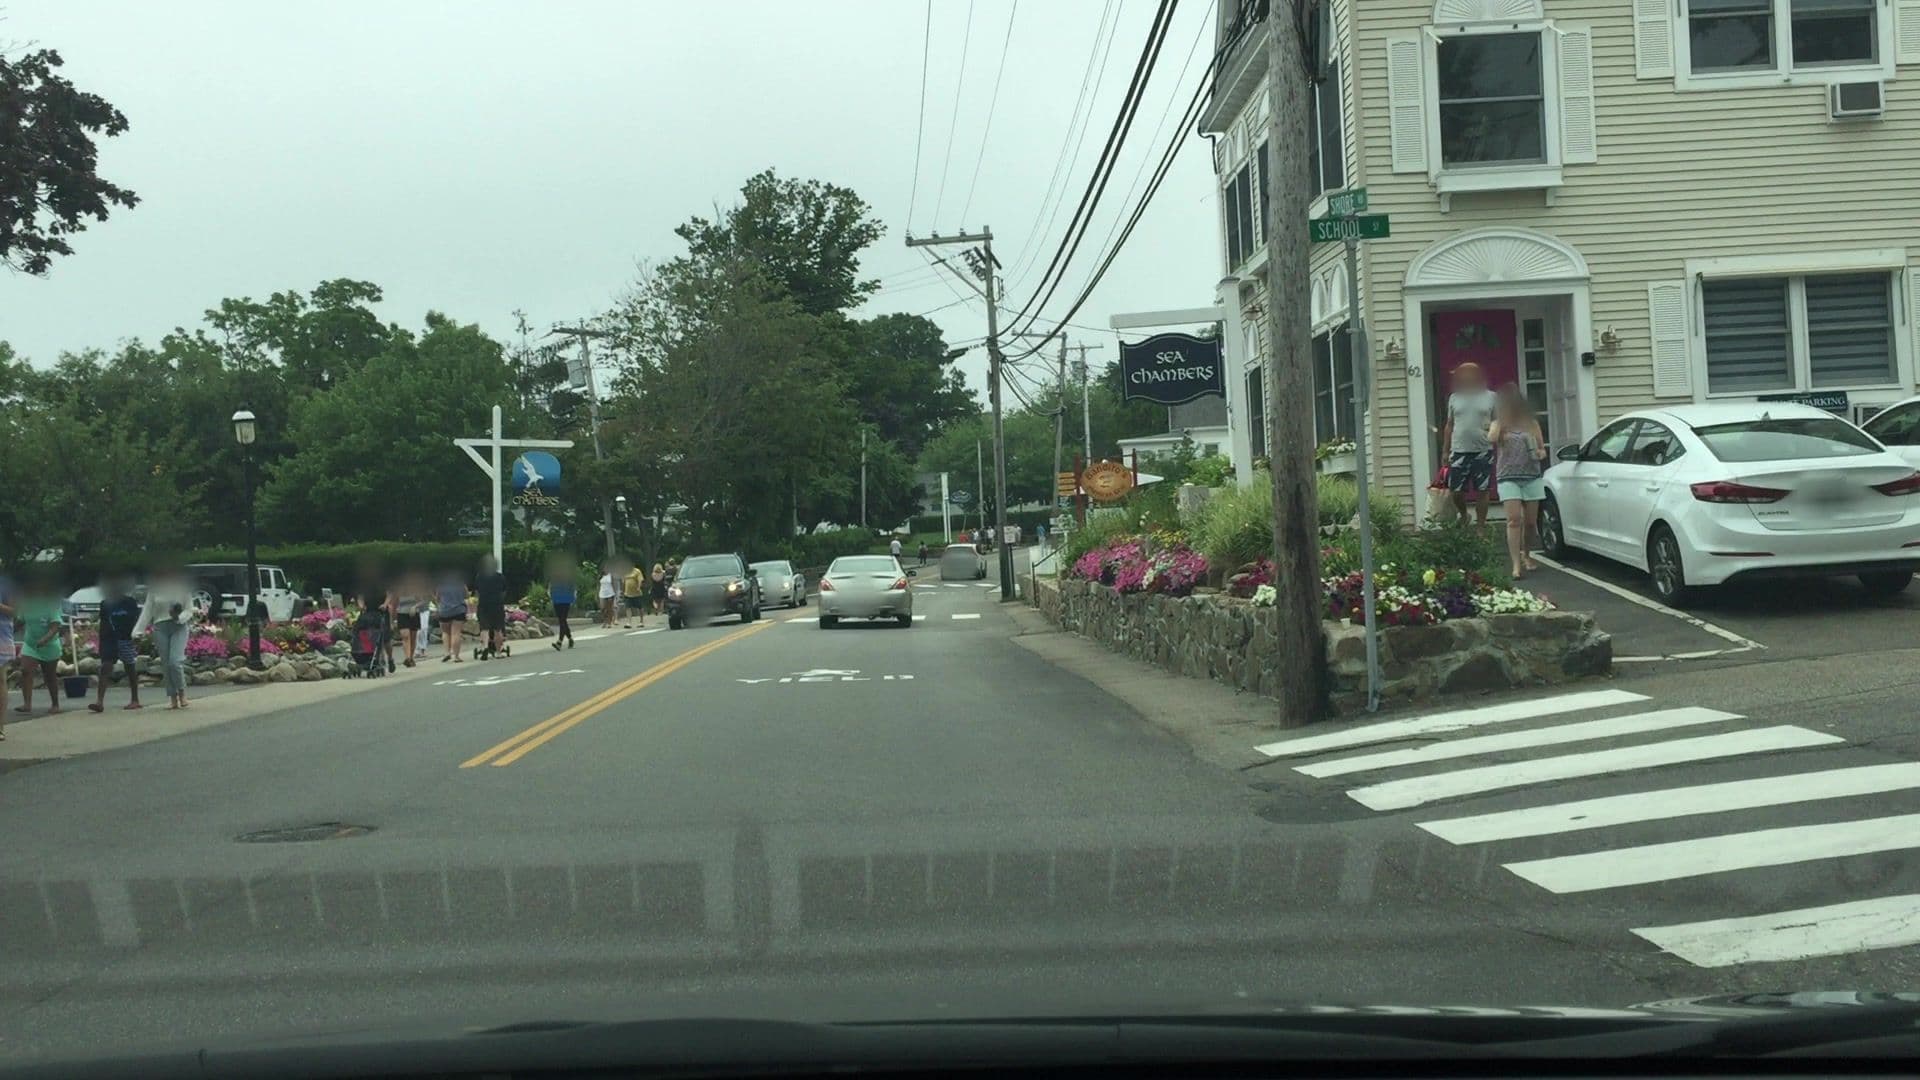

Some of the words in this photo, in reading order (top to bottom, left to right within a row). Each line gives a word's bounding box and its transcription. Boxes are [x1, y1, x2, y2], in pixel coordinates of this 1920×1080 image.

[1329, 193, 1354, 215] SHORE
[1318, 220, 1363, 239] SCHOOL
[1155, 351, 1186, 364] SEA
[1131, 365, 1214, 384] CHAMBERS
[1408, 365, 1421, 377] 62
[1802, 396, 1845, 407] PARKING
